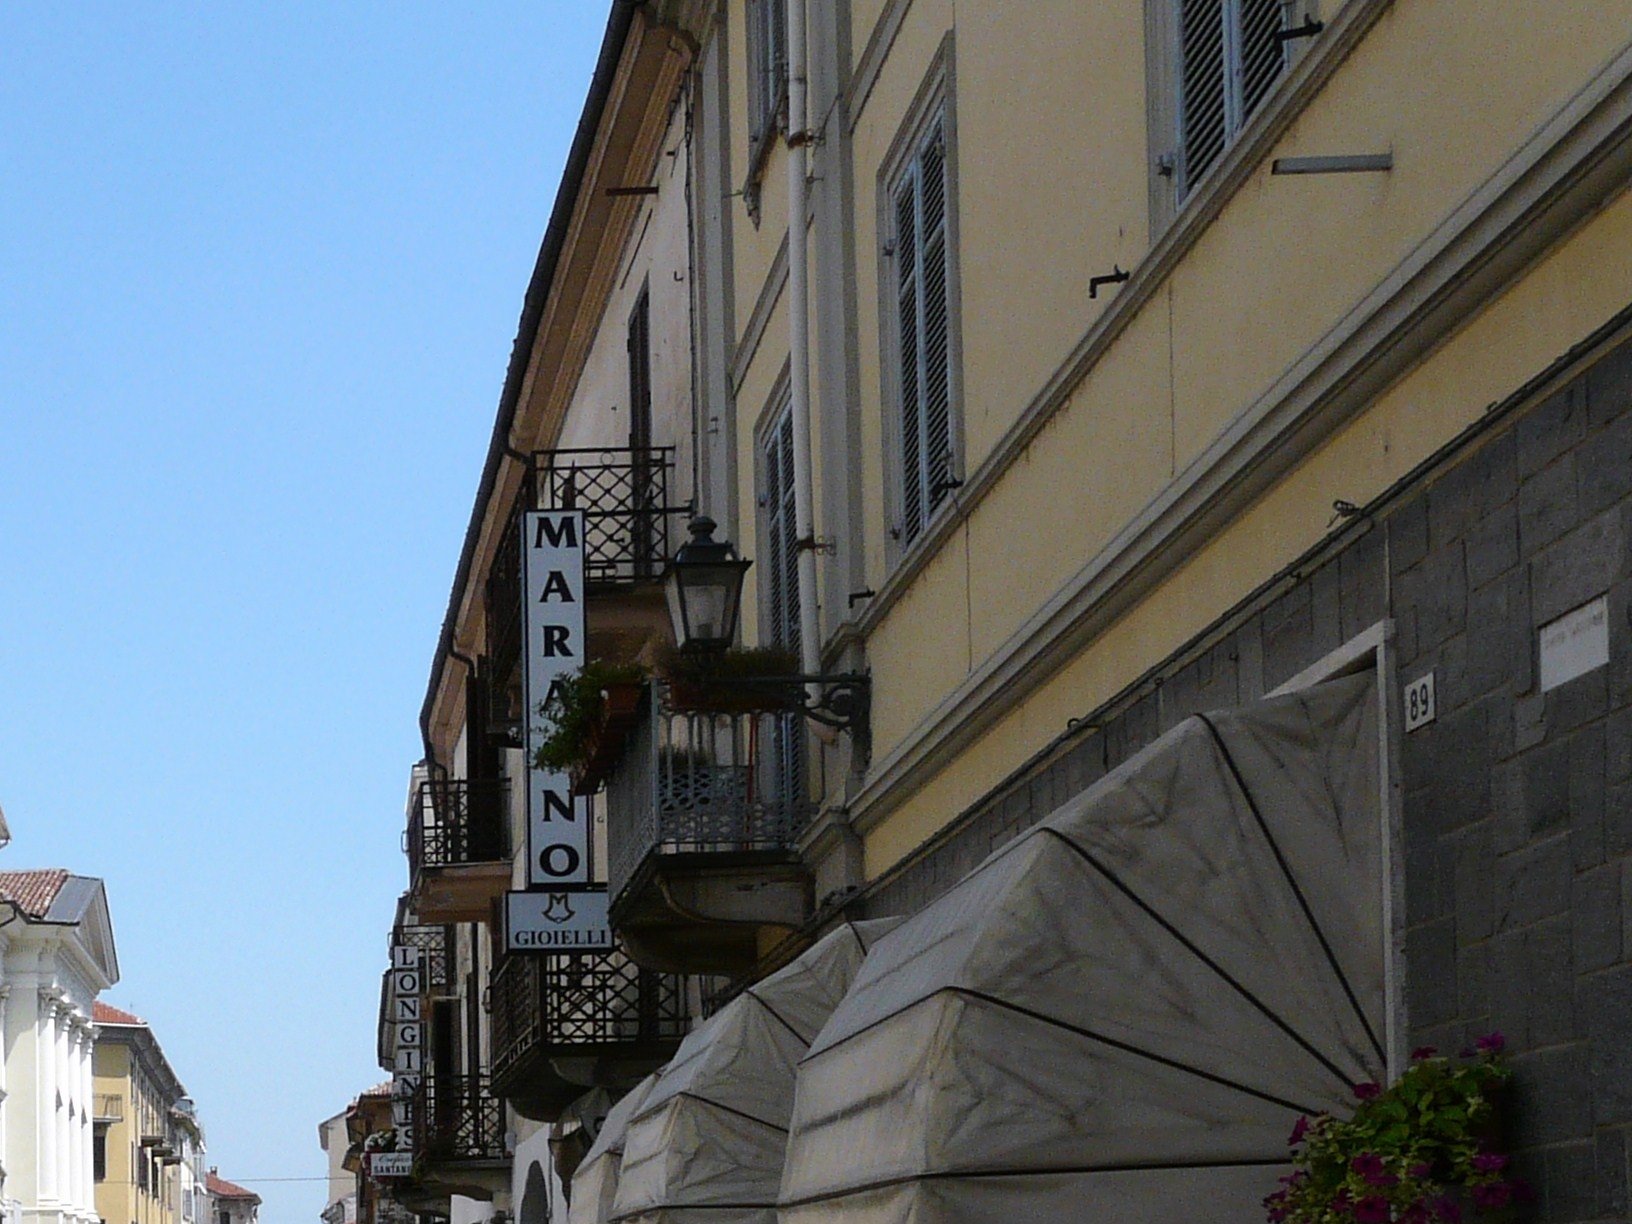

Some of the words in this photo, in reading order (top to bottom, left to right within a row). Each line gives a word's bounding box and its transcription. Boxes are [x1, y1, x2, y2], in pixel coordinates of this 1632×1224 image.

[533, 515, 581, 877] MARANO
[1410, 683, 1428, 721] 89
[514, 929, 606, 946] GIOIELLI
